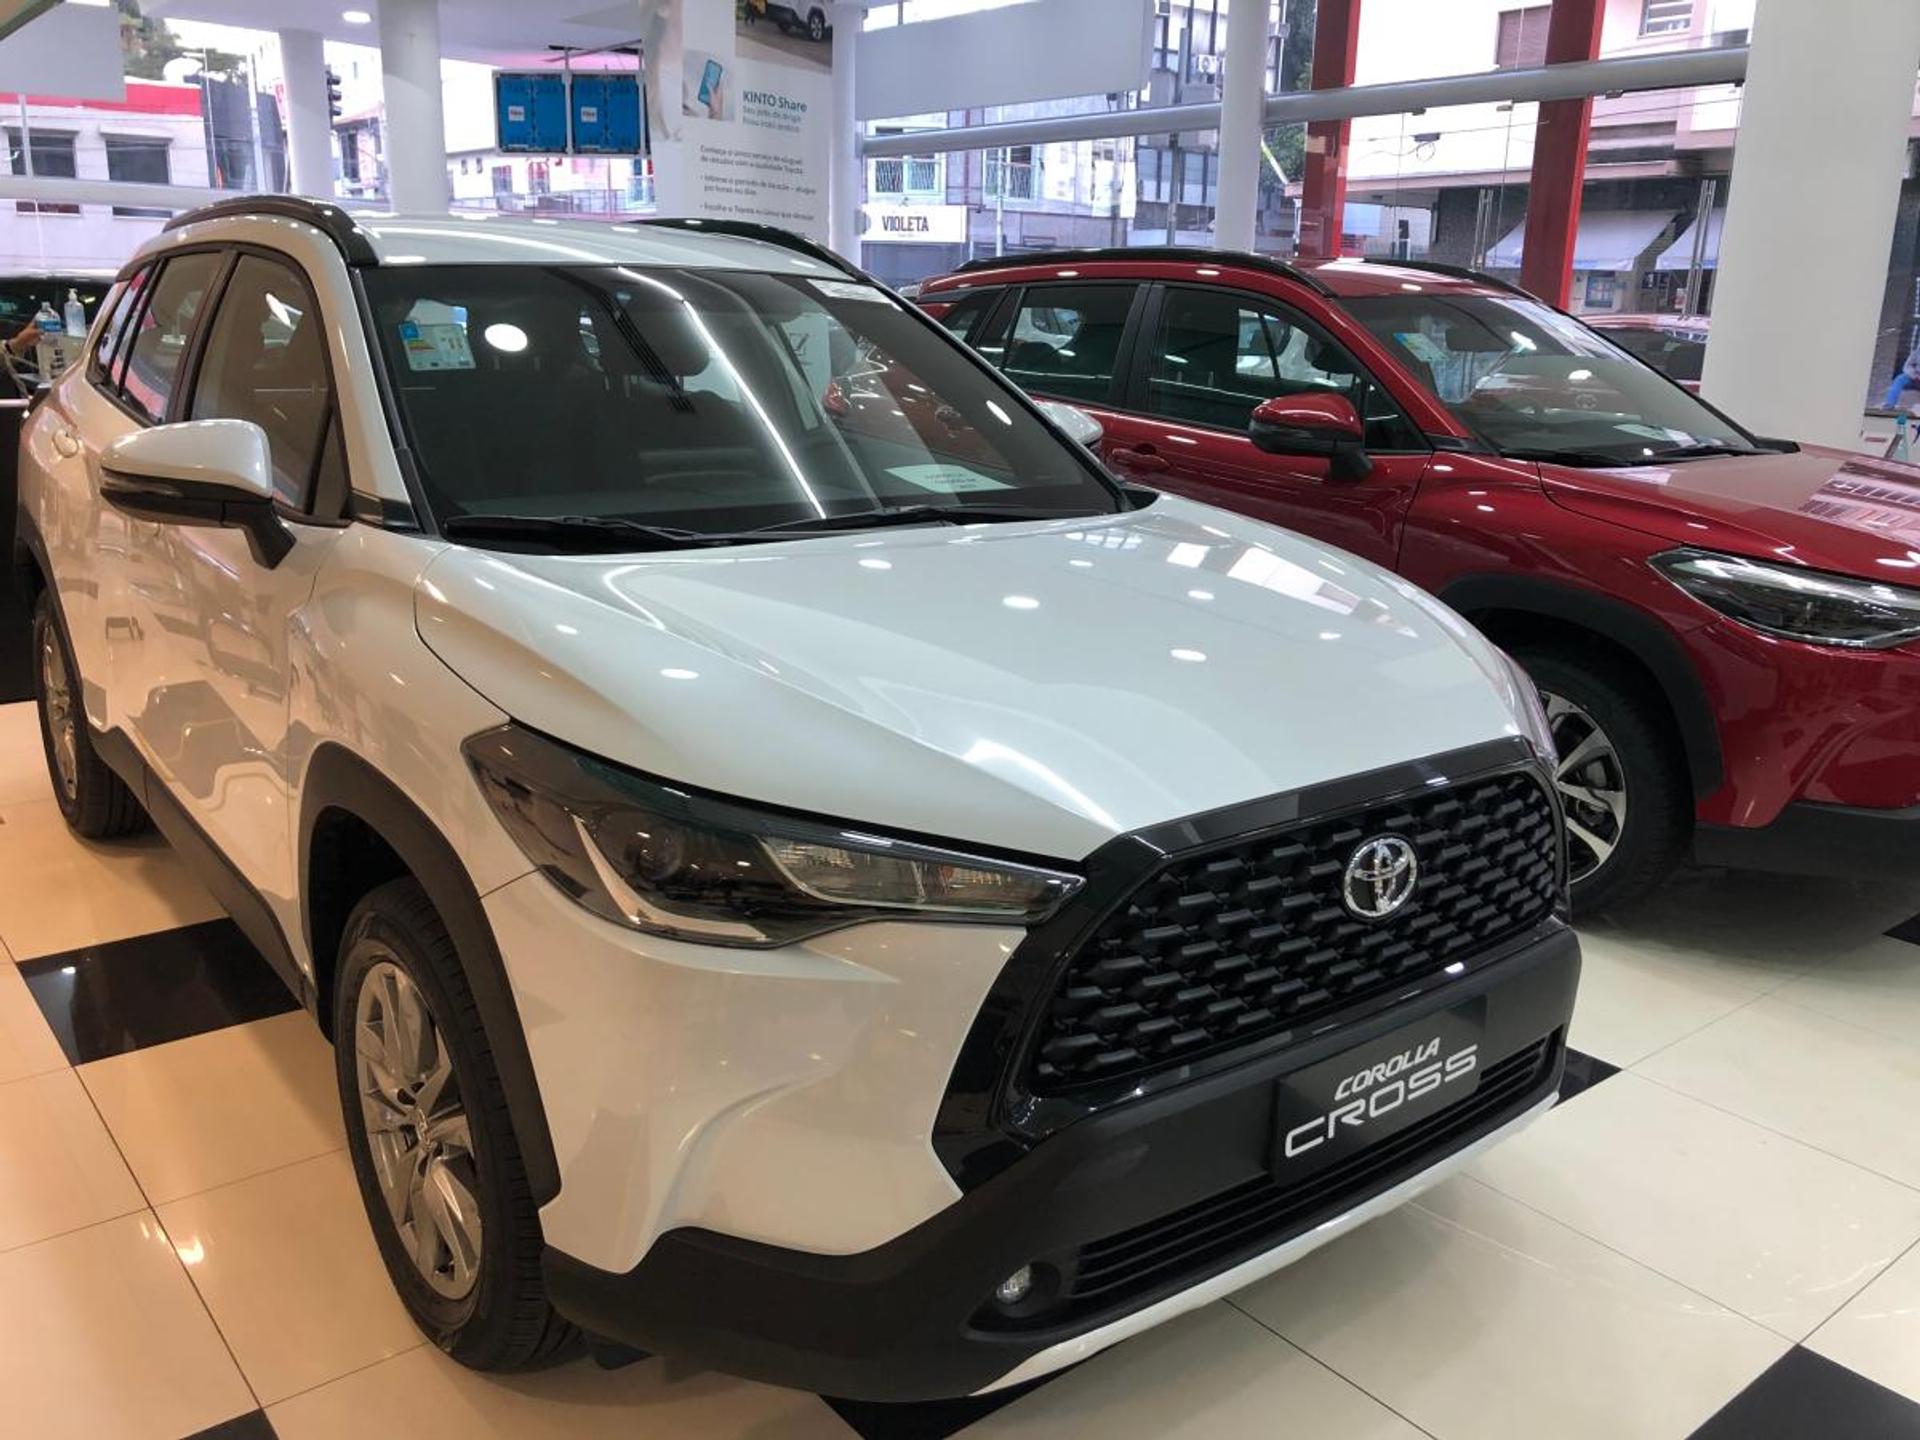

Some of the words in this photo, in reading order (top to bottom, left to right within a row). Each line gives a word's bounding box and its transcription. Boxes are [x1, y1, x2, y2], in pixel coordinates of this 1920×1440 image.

[742, 90, 776, 107] KINTO
[779, 96, 808, 112] Share
[881, 215, 930, 232] VIOLETA
[1334, 1037, 1441, 1101] COROLLA
[1285, 1044, 1478, 1158] CROSS
